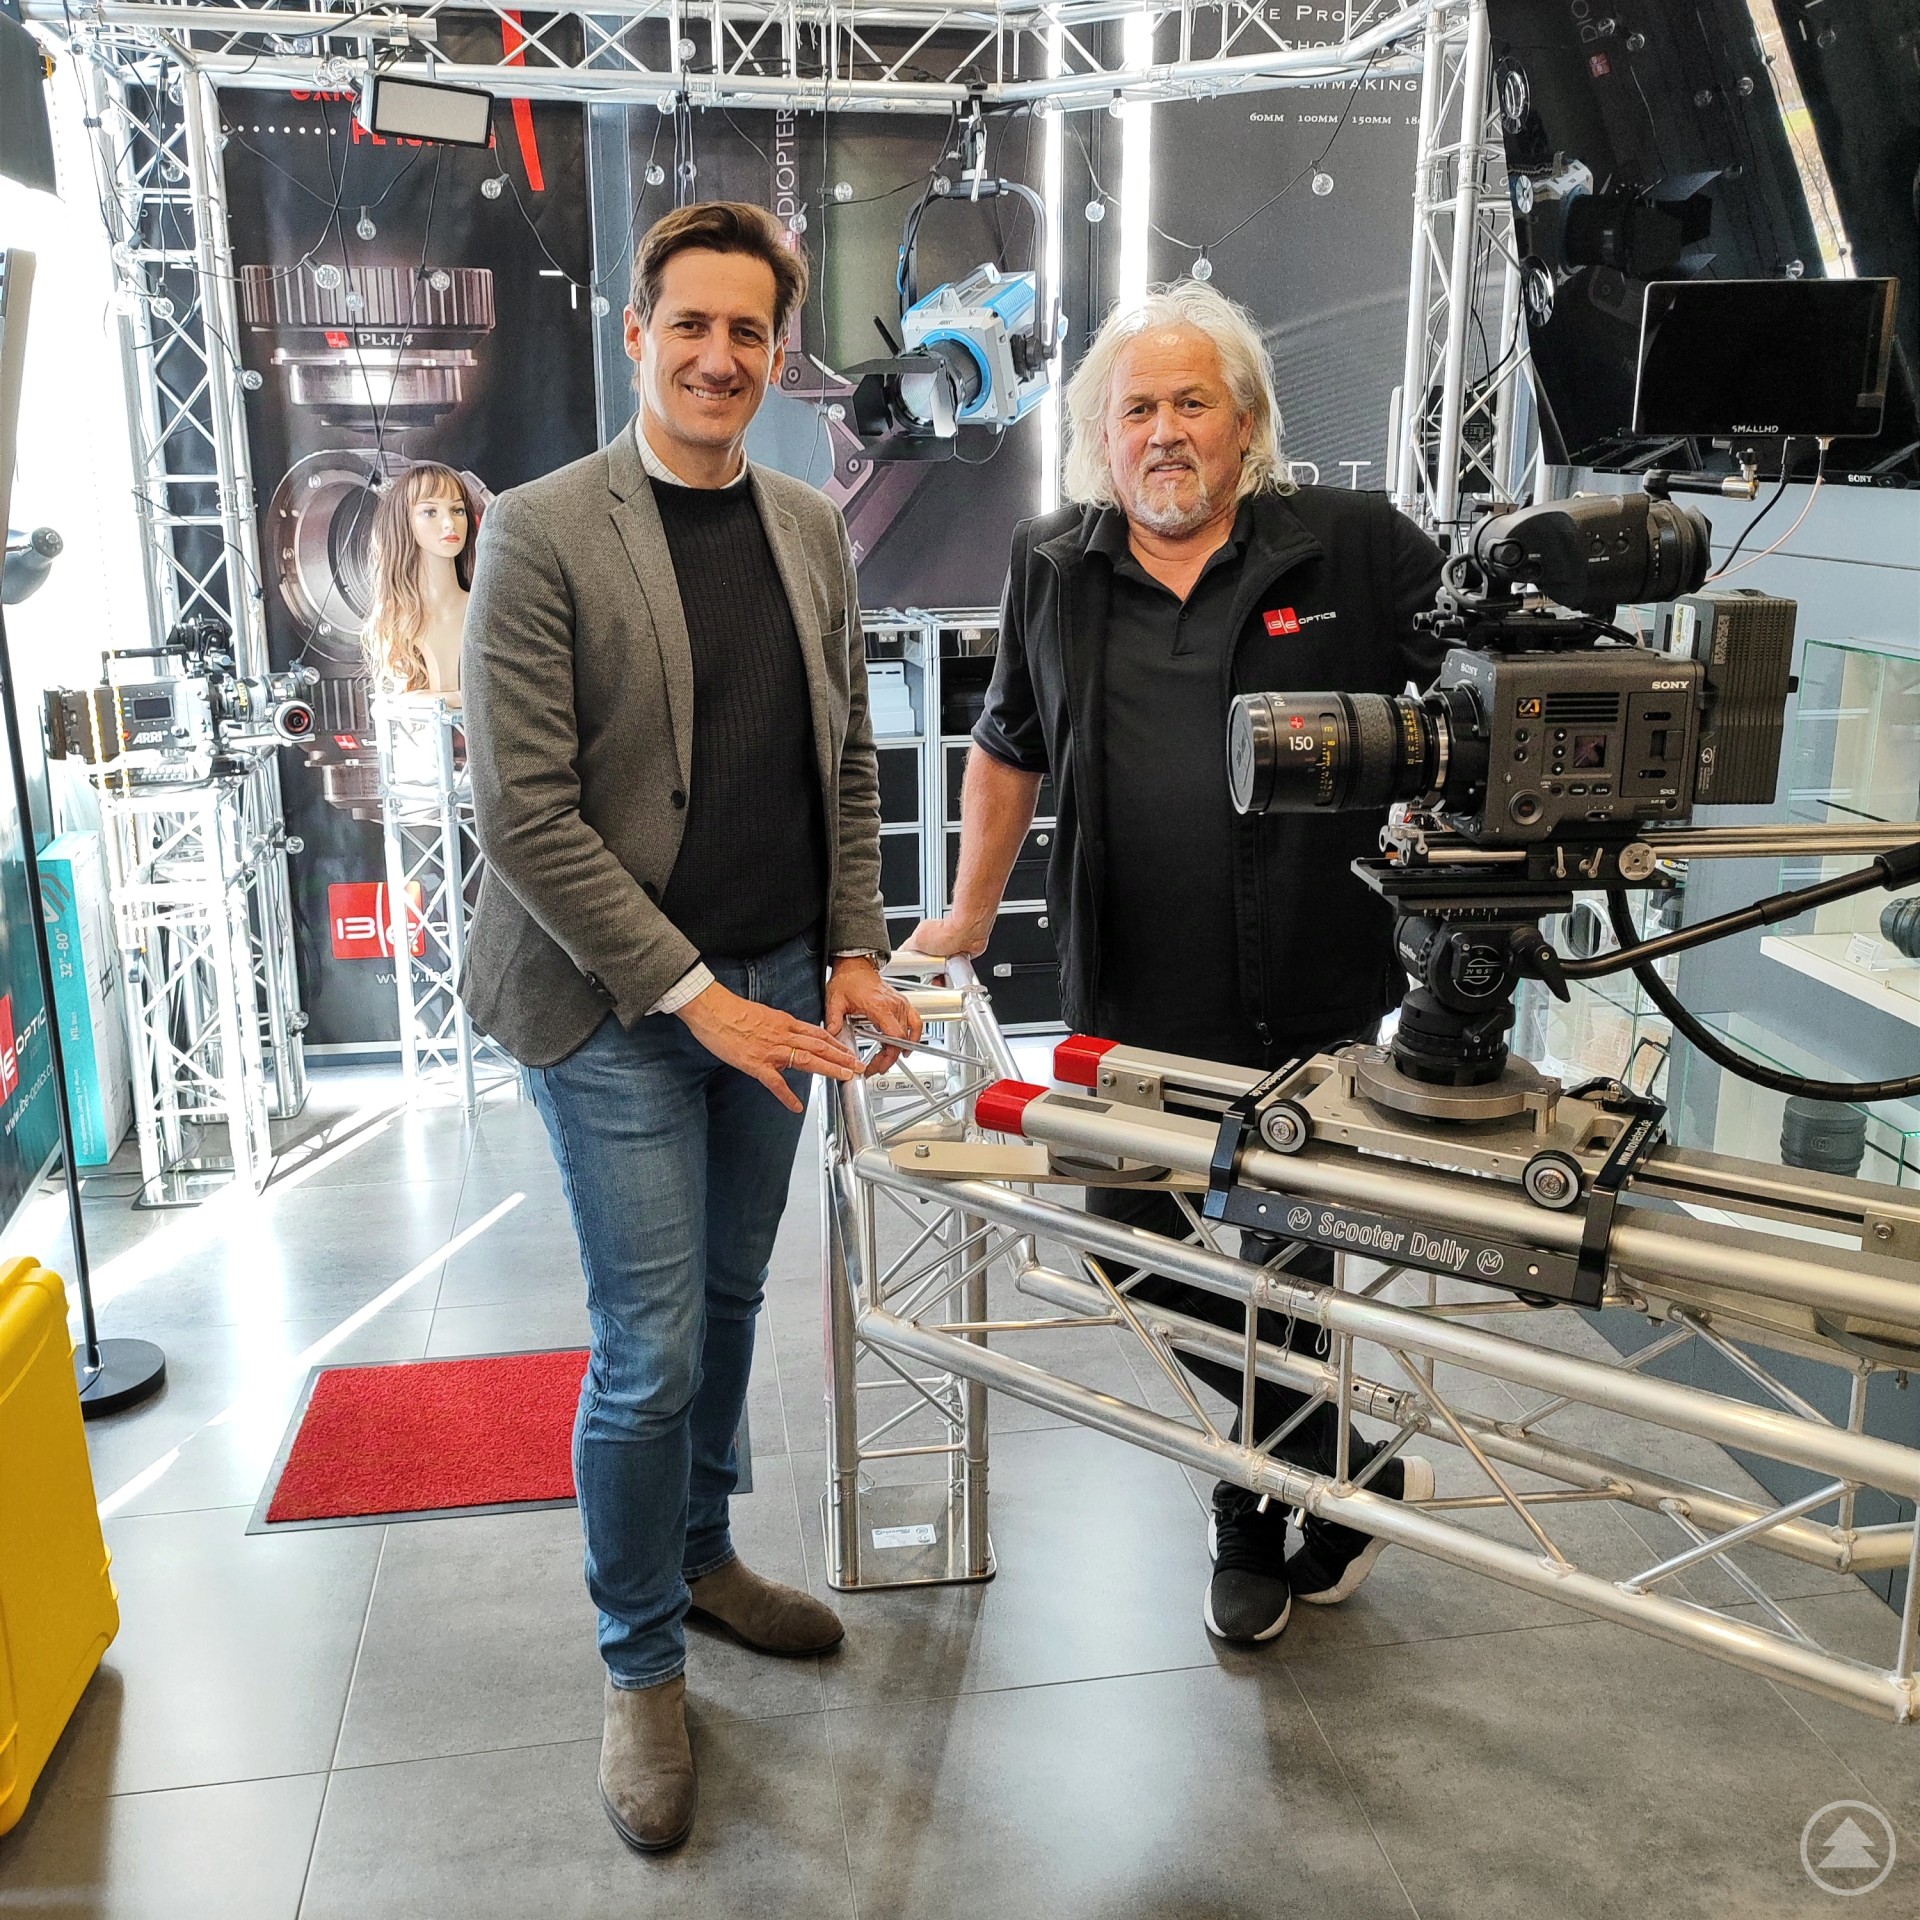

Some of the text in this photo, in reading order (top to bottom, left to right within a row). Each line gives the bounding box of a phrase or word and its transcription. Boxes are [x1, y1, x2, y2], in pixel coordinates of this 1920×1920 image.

[1732, 424, 1779, 433] SMALLHD
[1847, 474, 1872, 483] SONY
[1460, 662, 1479, 676] SONY
[1651, 681, 1690, 689] SONY
[132, 731, 163, 745] ARRI
[1288, 736, 1314, 751] 150
[15, 1006, 47, 1056] OPTIC
[1318, 1211, 1405, 1251] Scooter
[1409, 1231, 1470, 1271] Dolly
